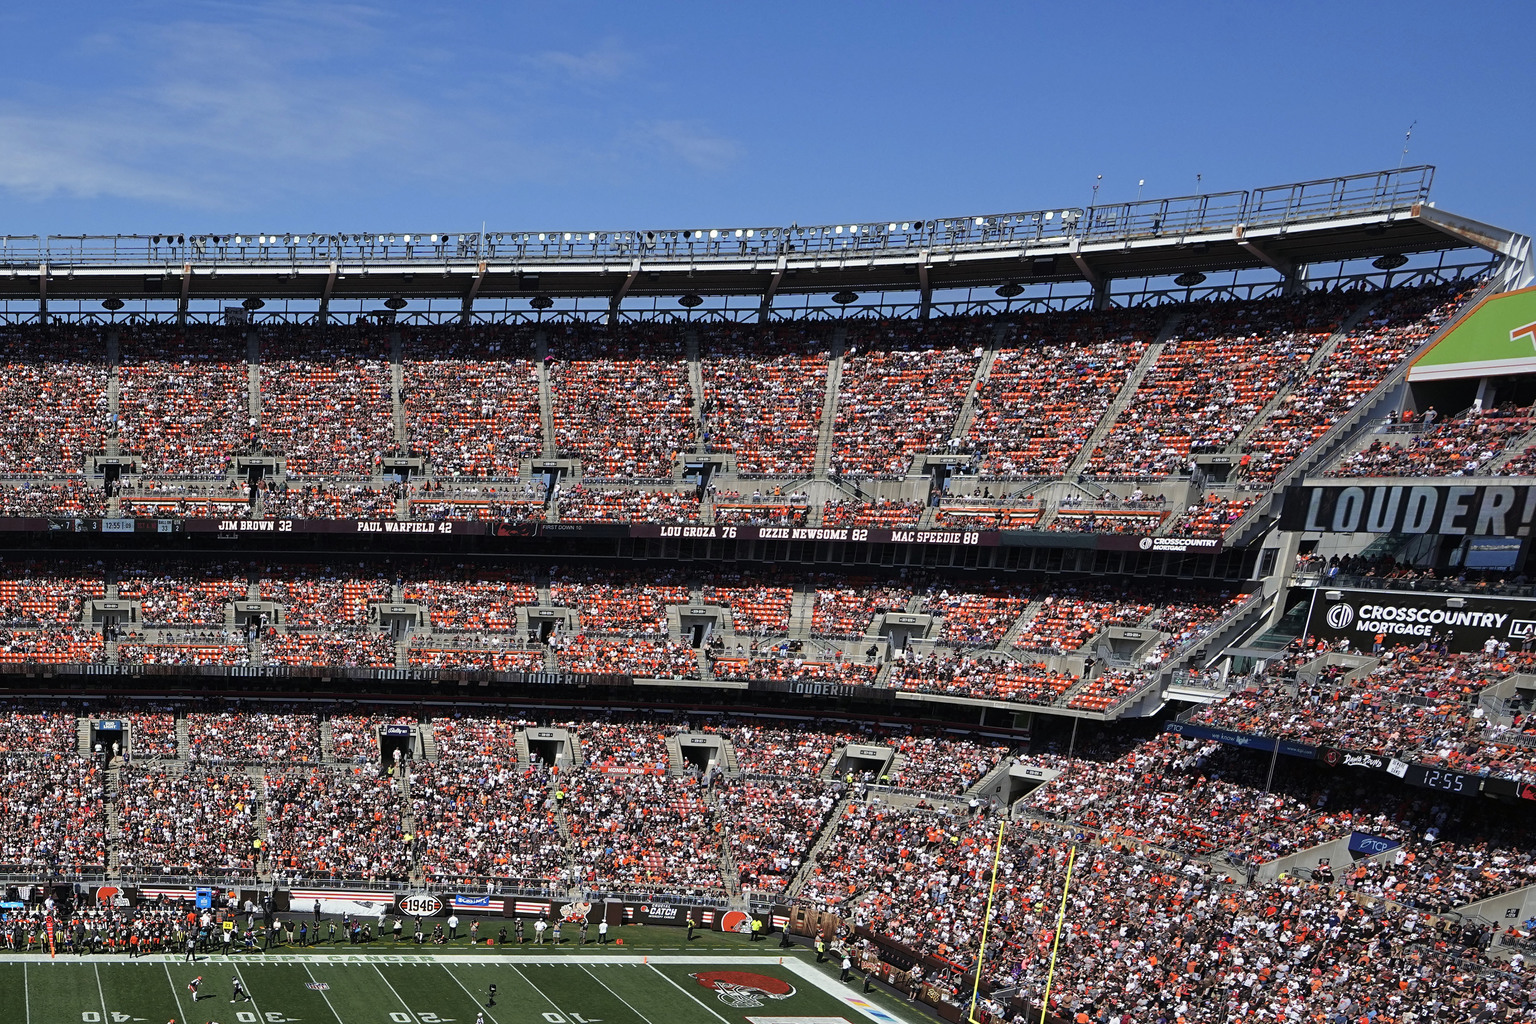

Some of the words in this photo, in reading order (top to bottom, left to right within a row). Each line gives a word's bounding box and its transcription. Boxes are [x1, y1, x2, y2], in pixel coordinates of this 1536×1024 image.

[66, 521, 70, 530] 7
[92, 521, 97, 530] 3
[218, 521, 238, 531] JIM
[240, 521, 275, 531] BROWN
[279, 521, 292, 531] 32
[357, 522, 382, 532] PAUL
[385, 522, 435, 533] WARFIELD
[438, 522, 452, 534] 42
[660, 526, 681, 537] LOU
[683, 527, 716, 538] GROZA
[721, 527, 737, 539] 76
[759, 528, 789, 539] OZZIE
[791, 528, 848, 541] NEWSOME
[851, 529, 868, 541] 82
[891, 531, 914, 543] MAC
[917, 531, 961, 544] SPEEDIE
[963, 532, 979, 545] 88
[1153, 537, 1218, 548] CROSSCOUNTRY
[1358, 605, 1508, 628] CROSSCOUNTRY
[1356, 620, 1433, 637] MORTGAGE
[789, 683, 854, 697] LOUDER!!!
[1221, 734, 1235, 742] know
[1423, 770, 1464, 792] 12:55
[1371, 842, 1388, 852] TCP
[407, 900, 434, 912] 1946
[649, 907, 677, 917] CATCH
